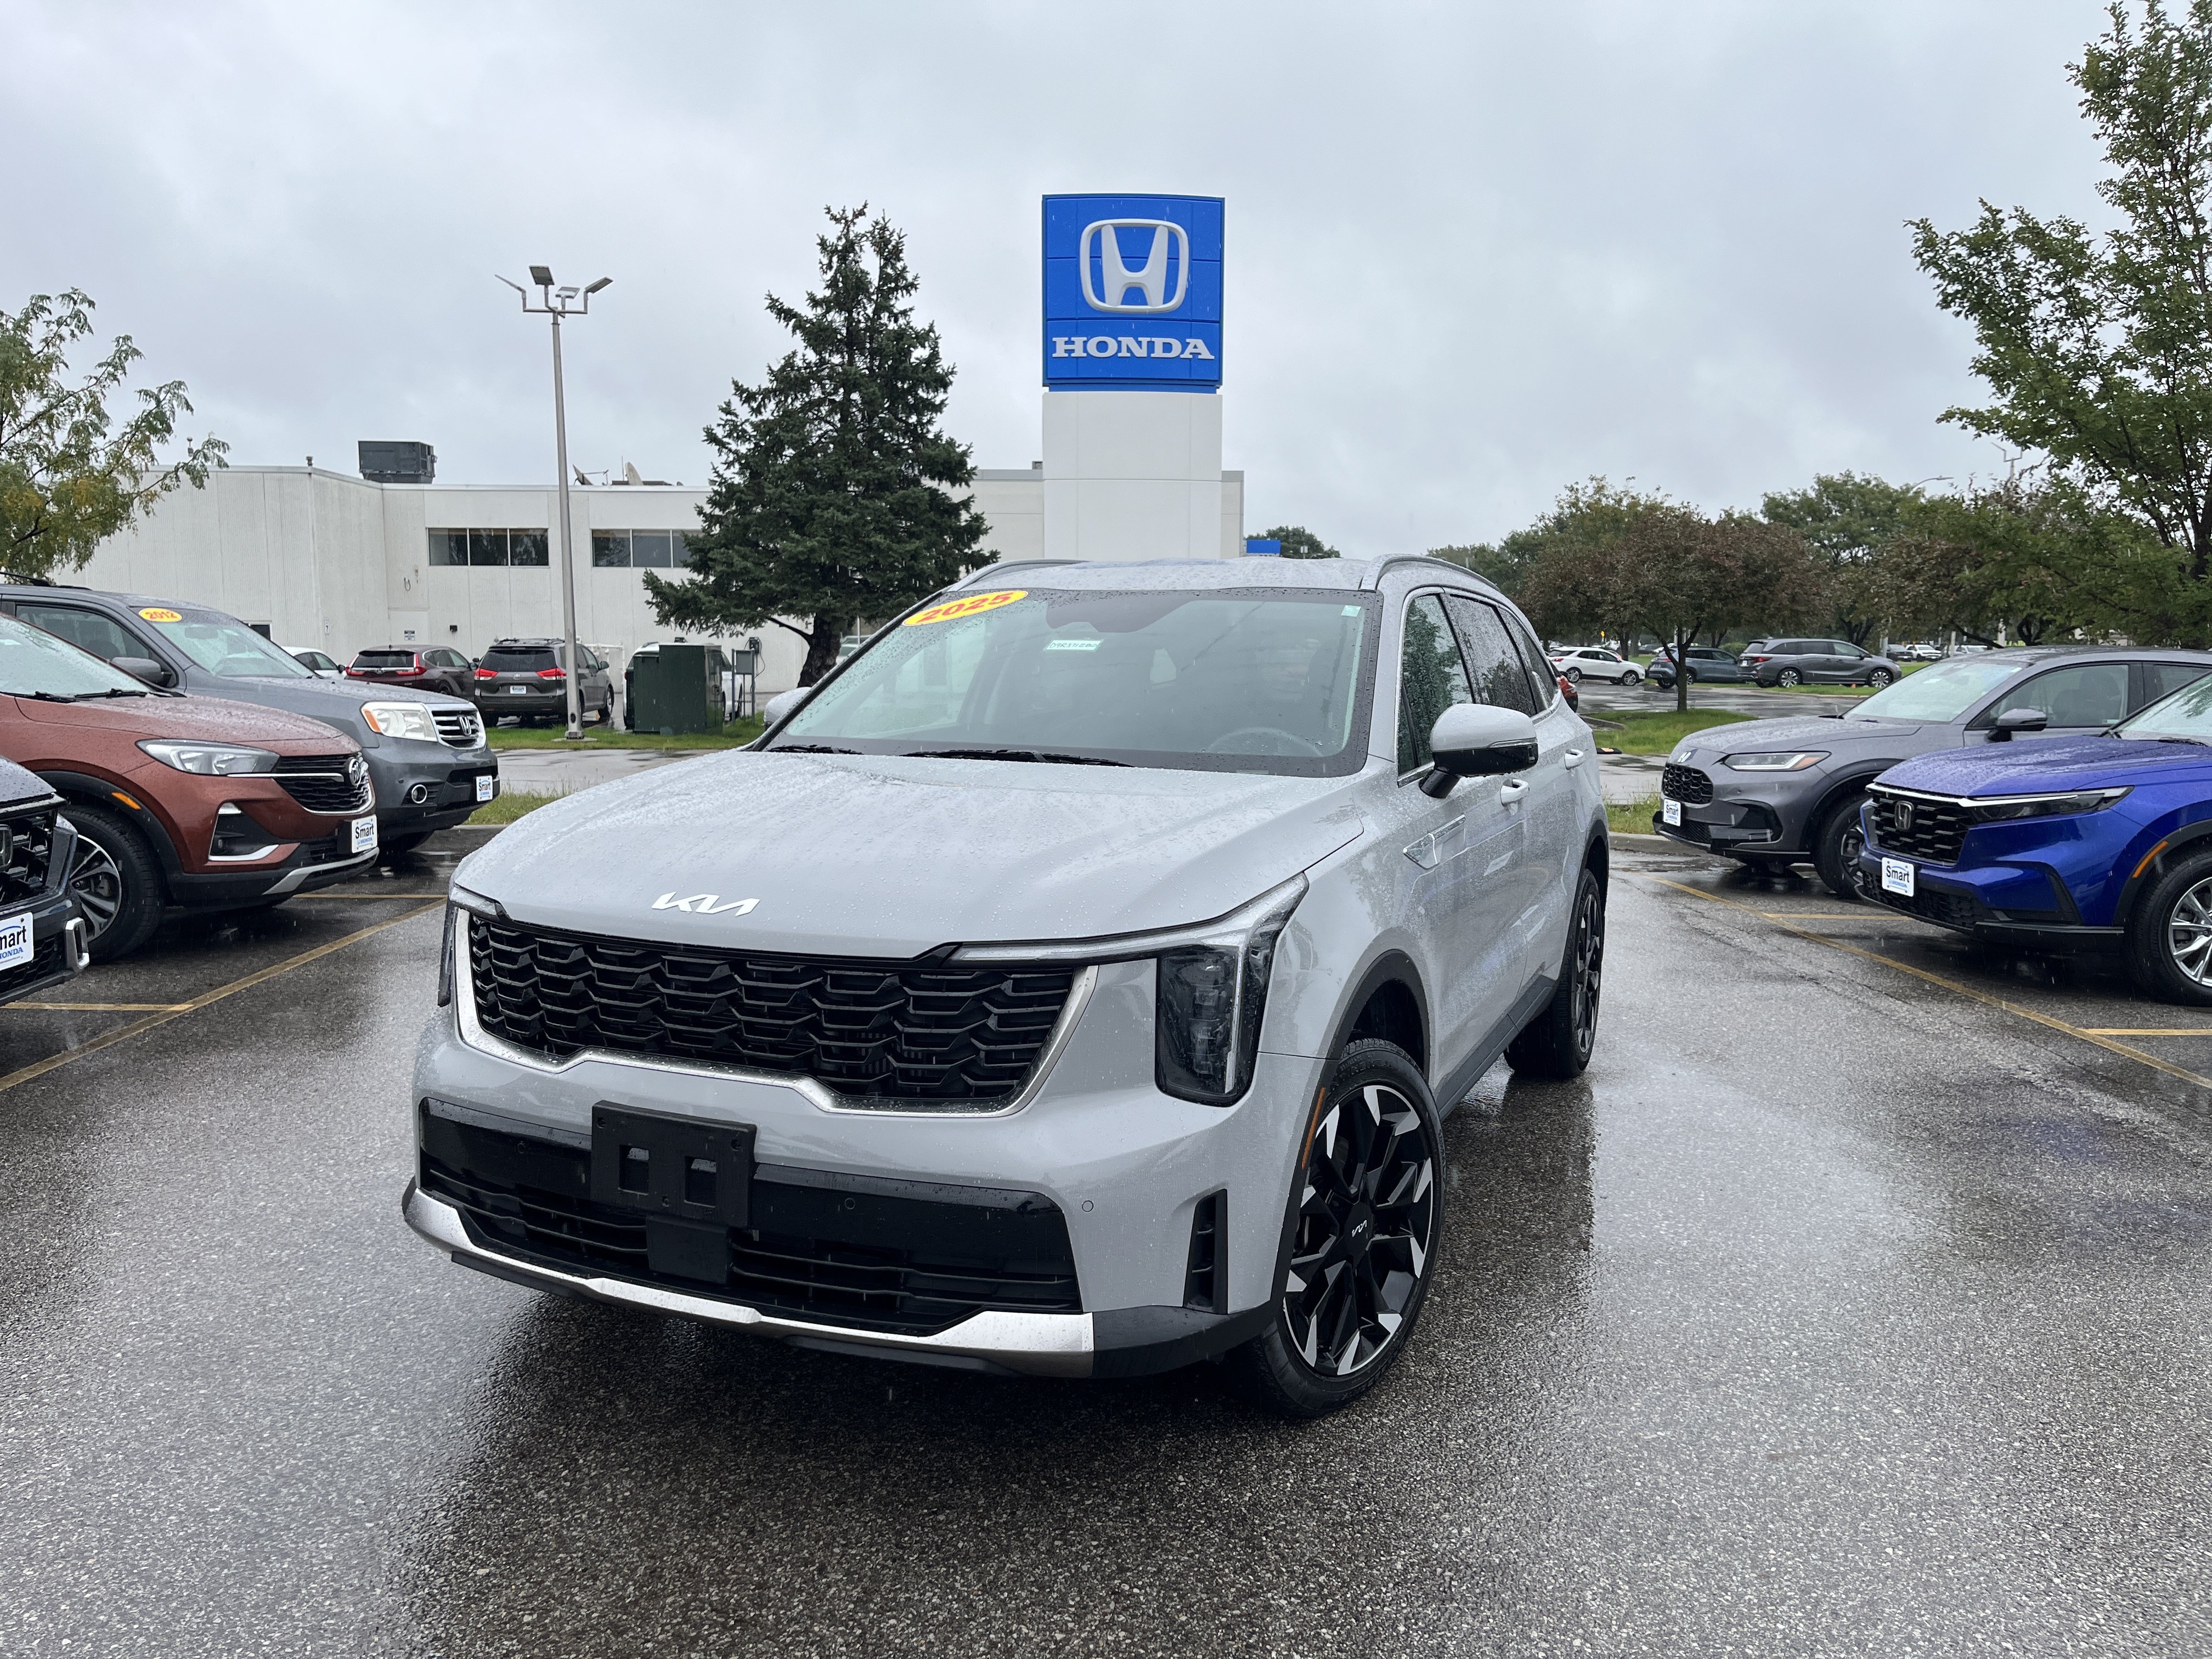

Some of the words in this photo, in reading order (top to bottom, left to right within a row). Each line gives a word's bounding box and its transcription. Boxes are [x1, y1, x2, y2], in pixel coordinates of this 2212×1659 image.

[1052, 336, 1215, 360] HONDA
[145, 611, 178, 620] 2012
[916, 592, 1014, 623] 2025
[355, 823, 374, 839] Smart
[1886, 865, 1910, 883] Smart
[651, 891, 760, 917] KIA
[0, 926, 27, 950] mart
